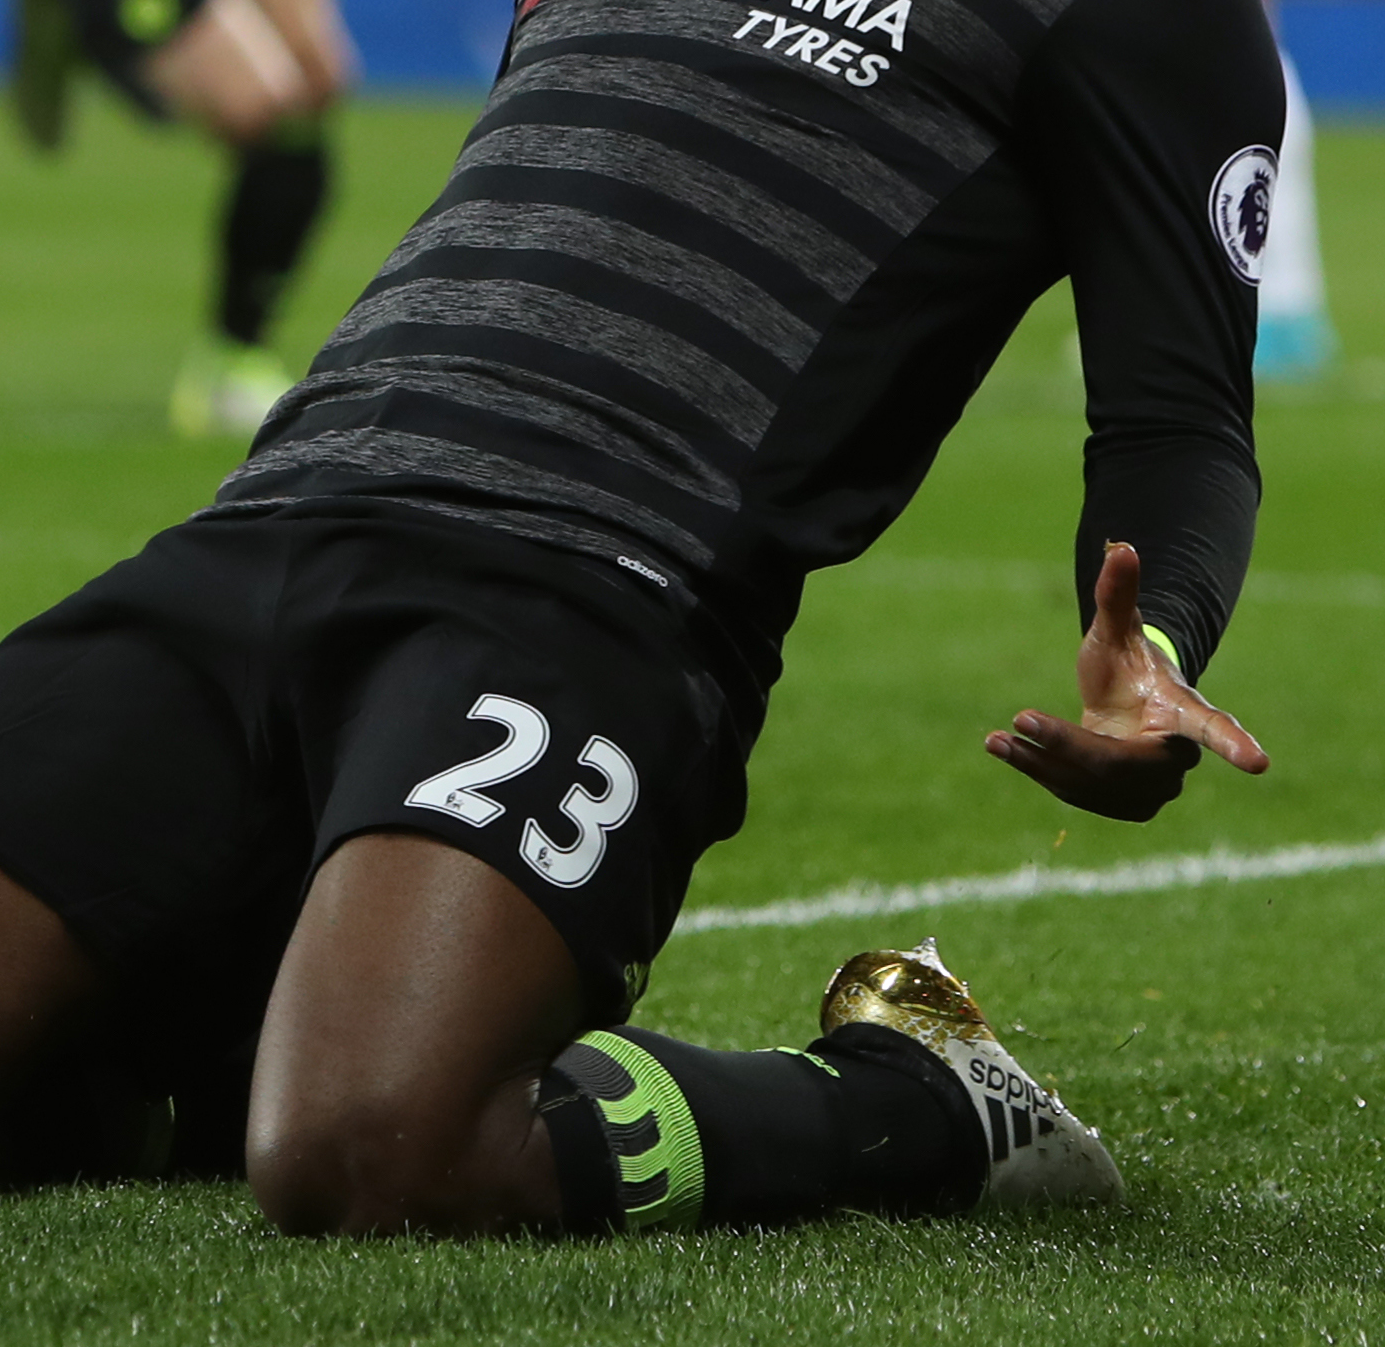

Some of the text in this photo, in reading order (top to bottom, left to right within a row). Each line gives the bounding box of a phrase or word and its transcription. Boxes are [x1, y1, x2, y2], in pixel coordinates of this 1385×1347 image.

[732, 9, 891, 88] TYRES
[1220, 193, 1232, 237] Premier
[616, 555, 669, 588] adizero
[404, 692, 640, 889] 23
